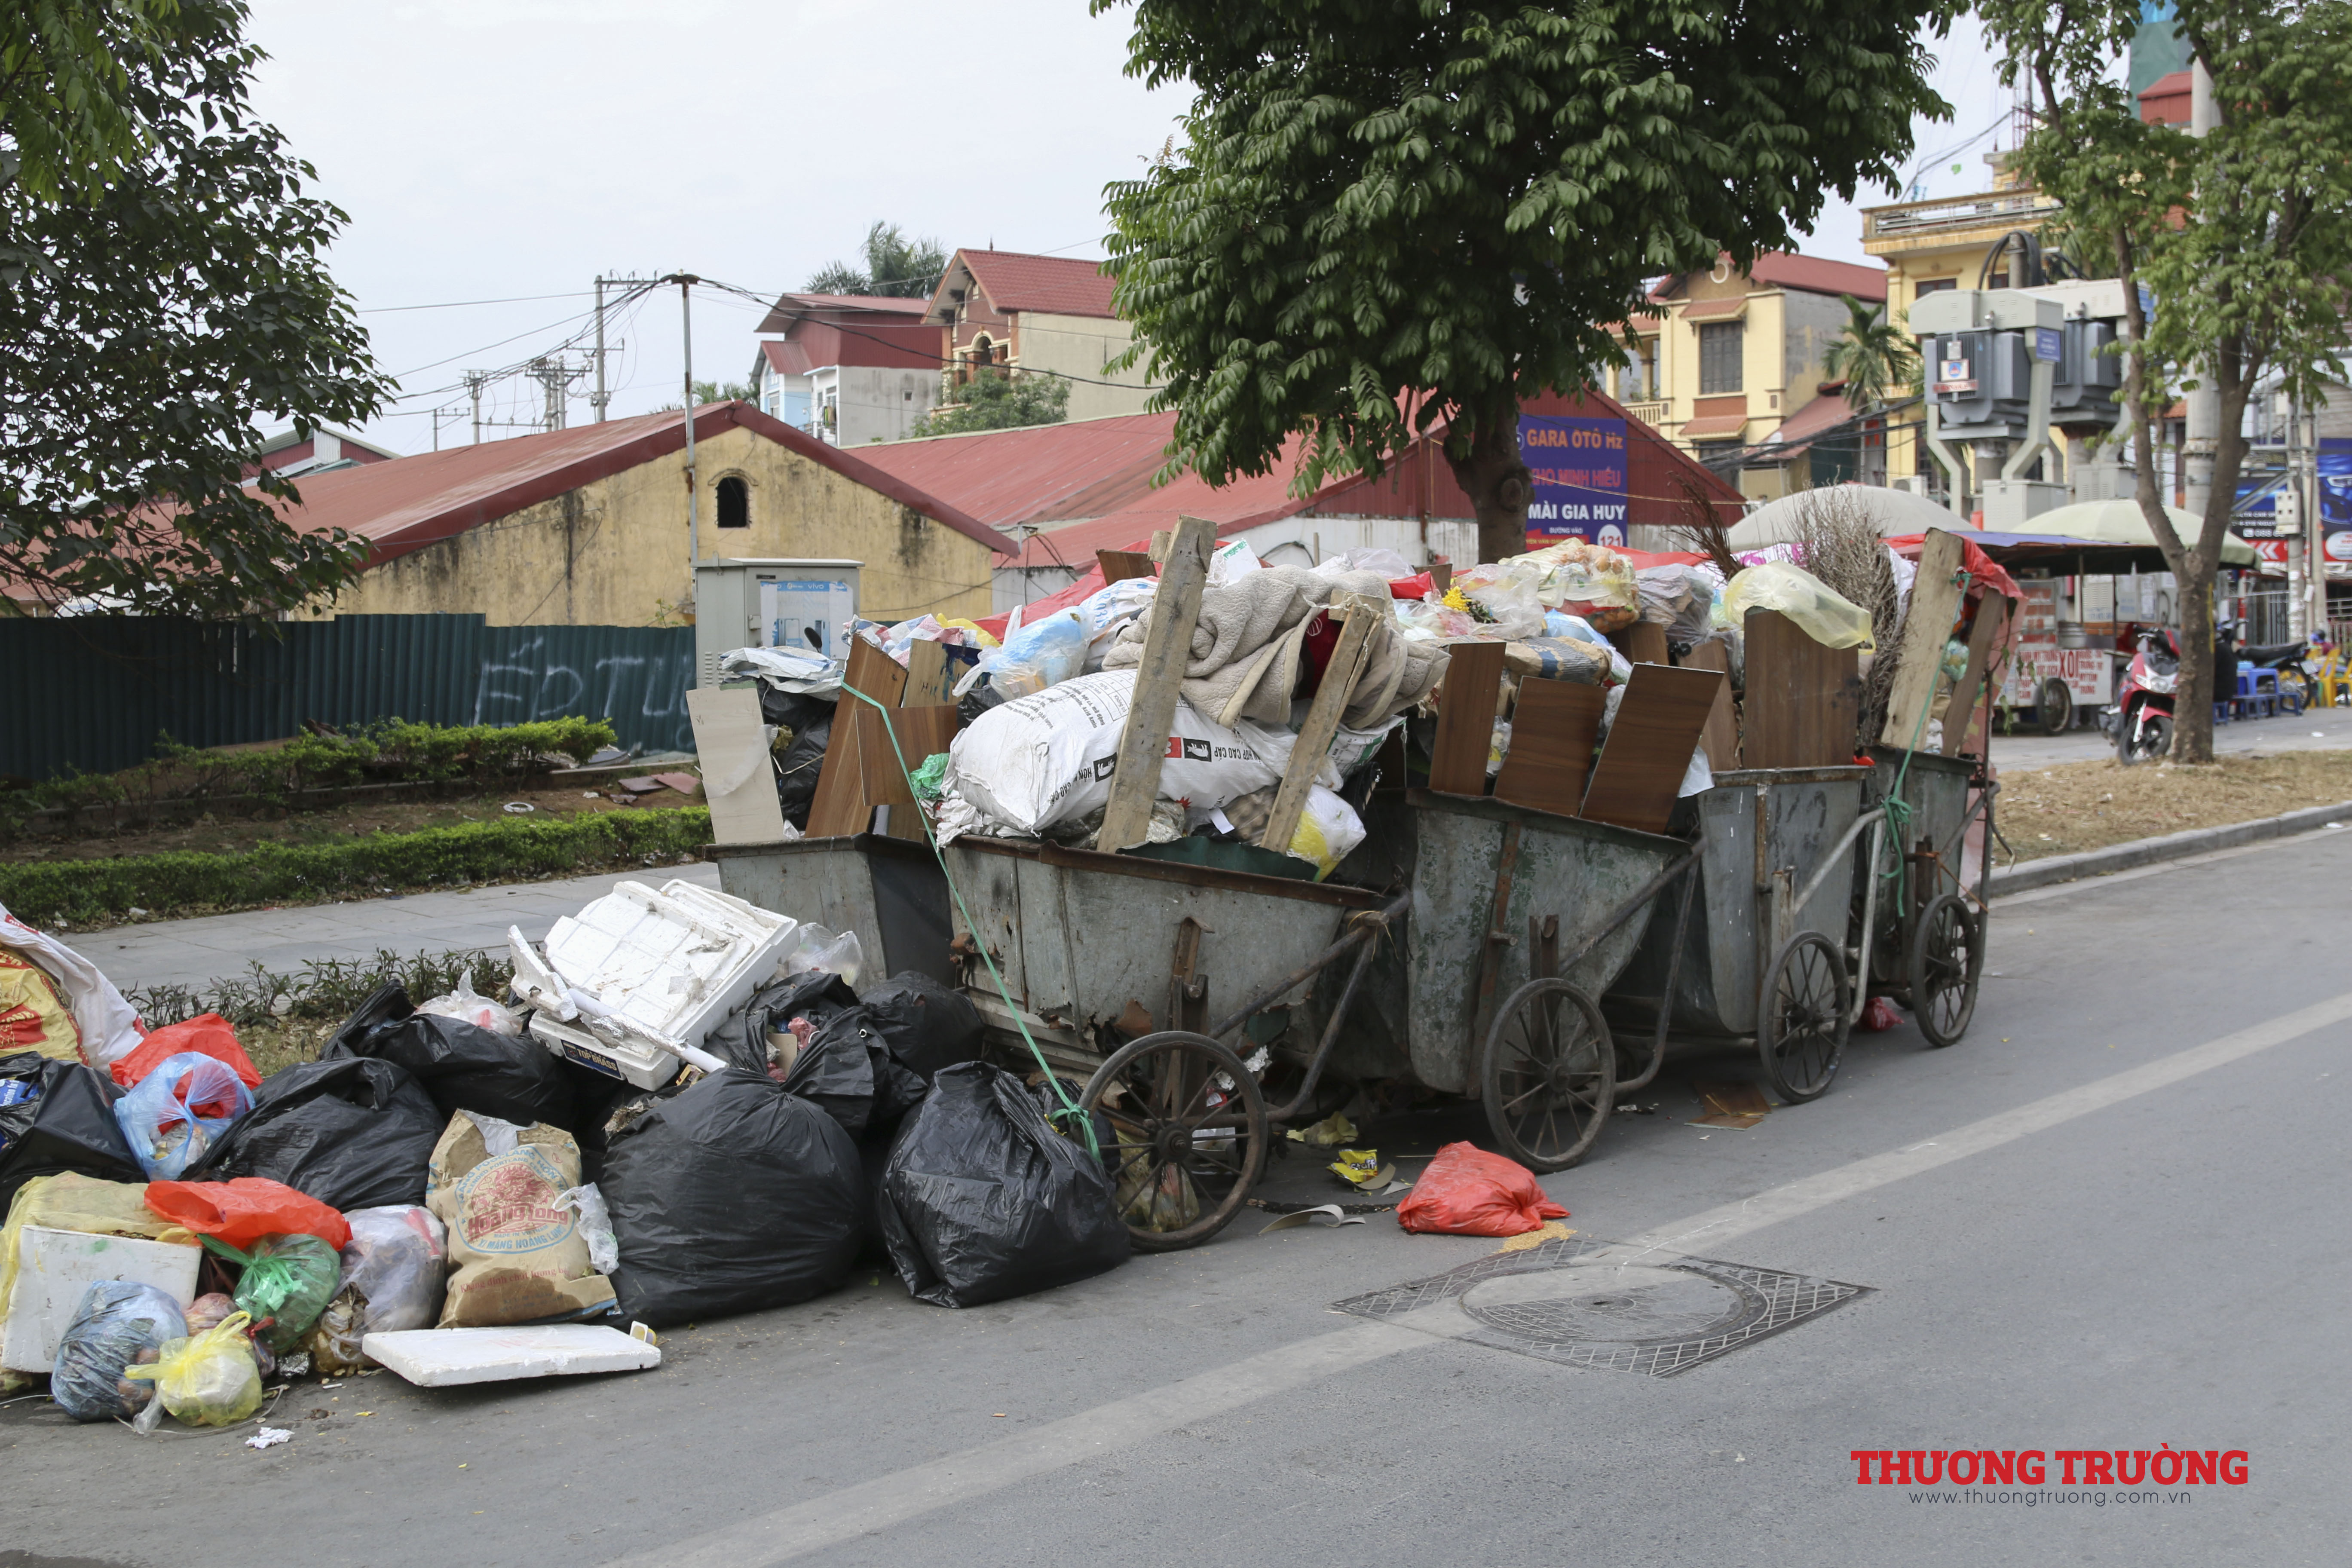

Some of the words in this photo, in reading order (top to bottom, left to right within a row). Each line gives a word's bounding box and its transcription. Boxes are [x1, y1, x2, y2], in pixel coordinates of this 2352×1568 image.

[1527, 429, 1568, 447] GARA
[1562, 504, 1589, 520] GIA
[1593, 505, 1626, 520] HUY
[1082, 706, 1090, 717] Acid
[1089, 714, 1097, 729] Amin
[1214, 746, 1227, 761] CẤP
[1228, 747, 1241, 760] CAO
[577, 1049, 592, 1060] TOP
[591, 1054, 618, 1071] BRASS
